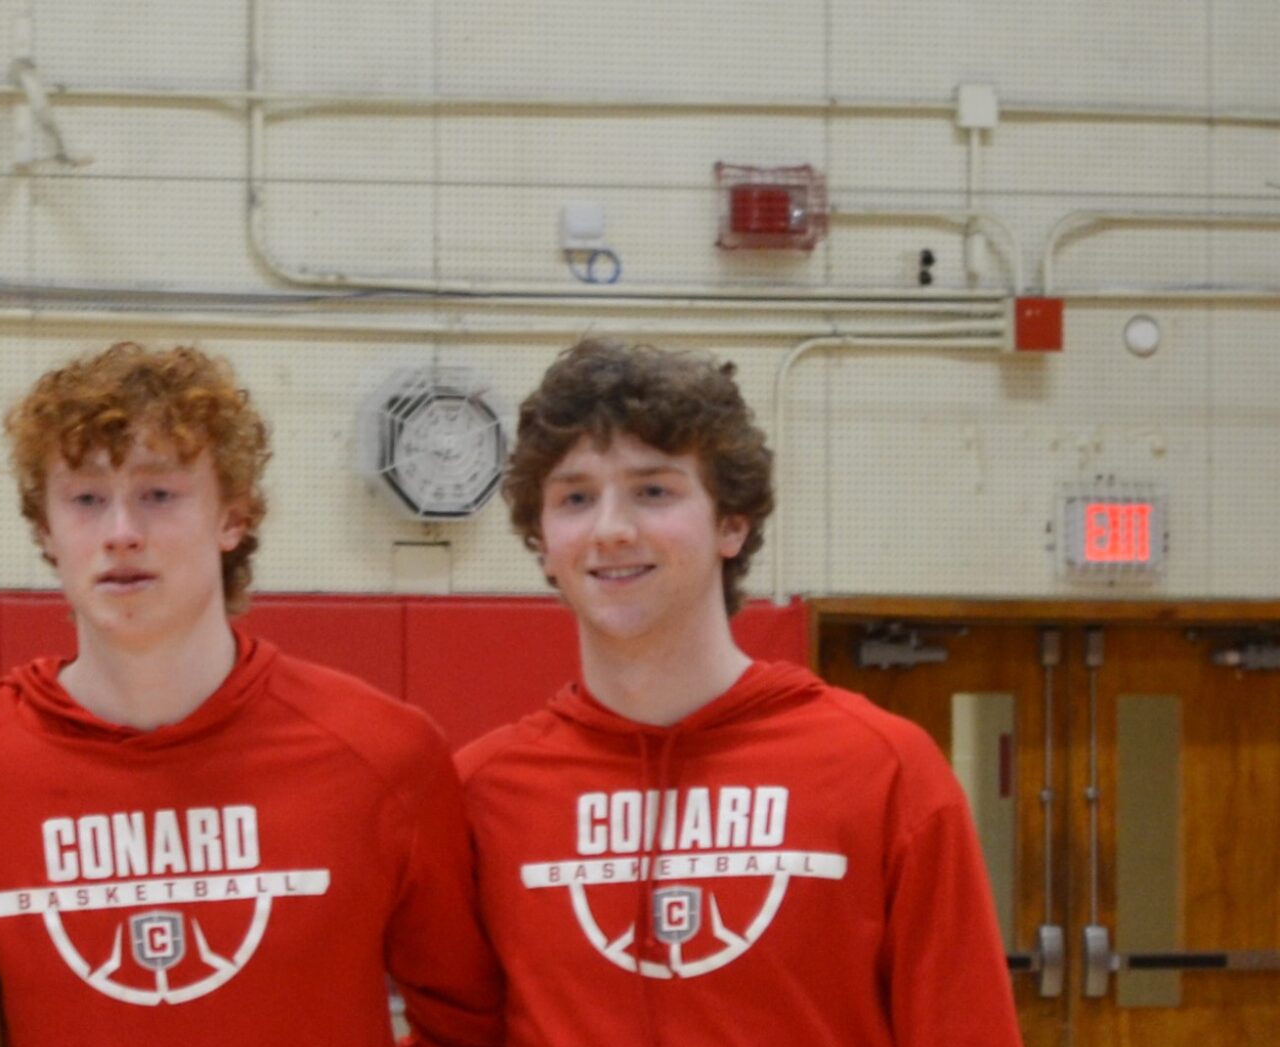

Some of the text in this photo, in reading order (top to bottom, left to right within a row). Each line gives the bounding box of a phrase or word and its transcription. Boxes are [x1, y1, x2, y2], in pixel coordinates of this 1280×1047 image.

[1084, 503, 1152, 562] EXIT
[42, 804, 261, 882] CONARD
[576, 786, 790, 856] CONARD
[17, 875, 298, 909] BASKETBALL
[666, 901, 685, 926] C
[147, 926, 168, 953] C
